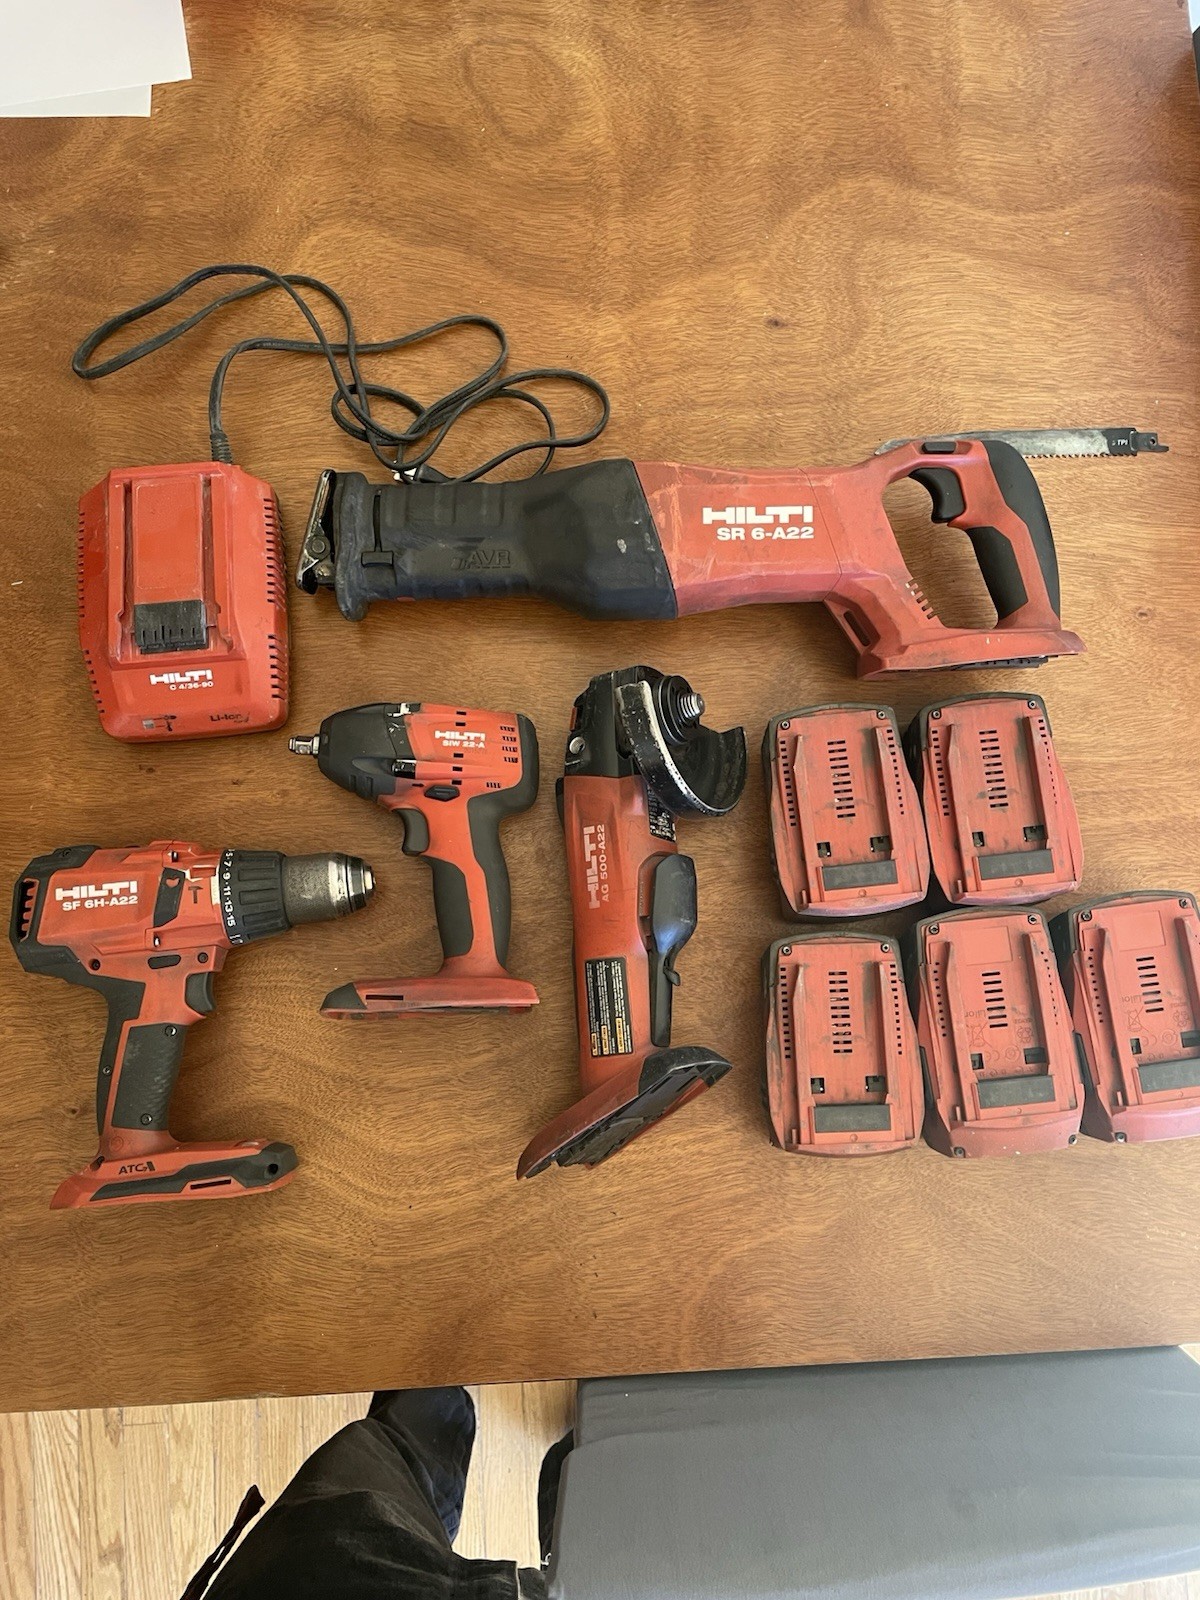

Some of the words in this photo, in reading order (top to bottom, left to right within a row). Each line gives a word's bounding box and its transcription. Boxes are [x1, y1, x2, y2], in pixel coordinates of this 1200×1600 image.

[702, 505, 814, 525] HILTI
[716, 527, 746, 541] SR
[751, 526, 815, 541] 6-A22
[149, 669, 213, 686] HILTI
[169, 683, 177, 691] C
[178, 680, 214, 690] 4/36-90
[434, 730, 486, 742] HILTI
[442, 739, 461, 748] SIW
[462, 740, 486, 749] 22-A
[596, 824, 608, 880] 500-A22
[583, 825, 601, 910] HILTI
[55, 880, 138, 901] HILTI
[600, 883, 610, 903] AG
[62, 900, 81, 912] SF
[84, 895, 139, 909] 6H-A22
